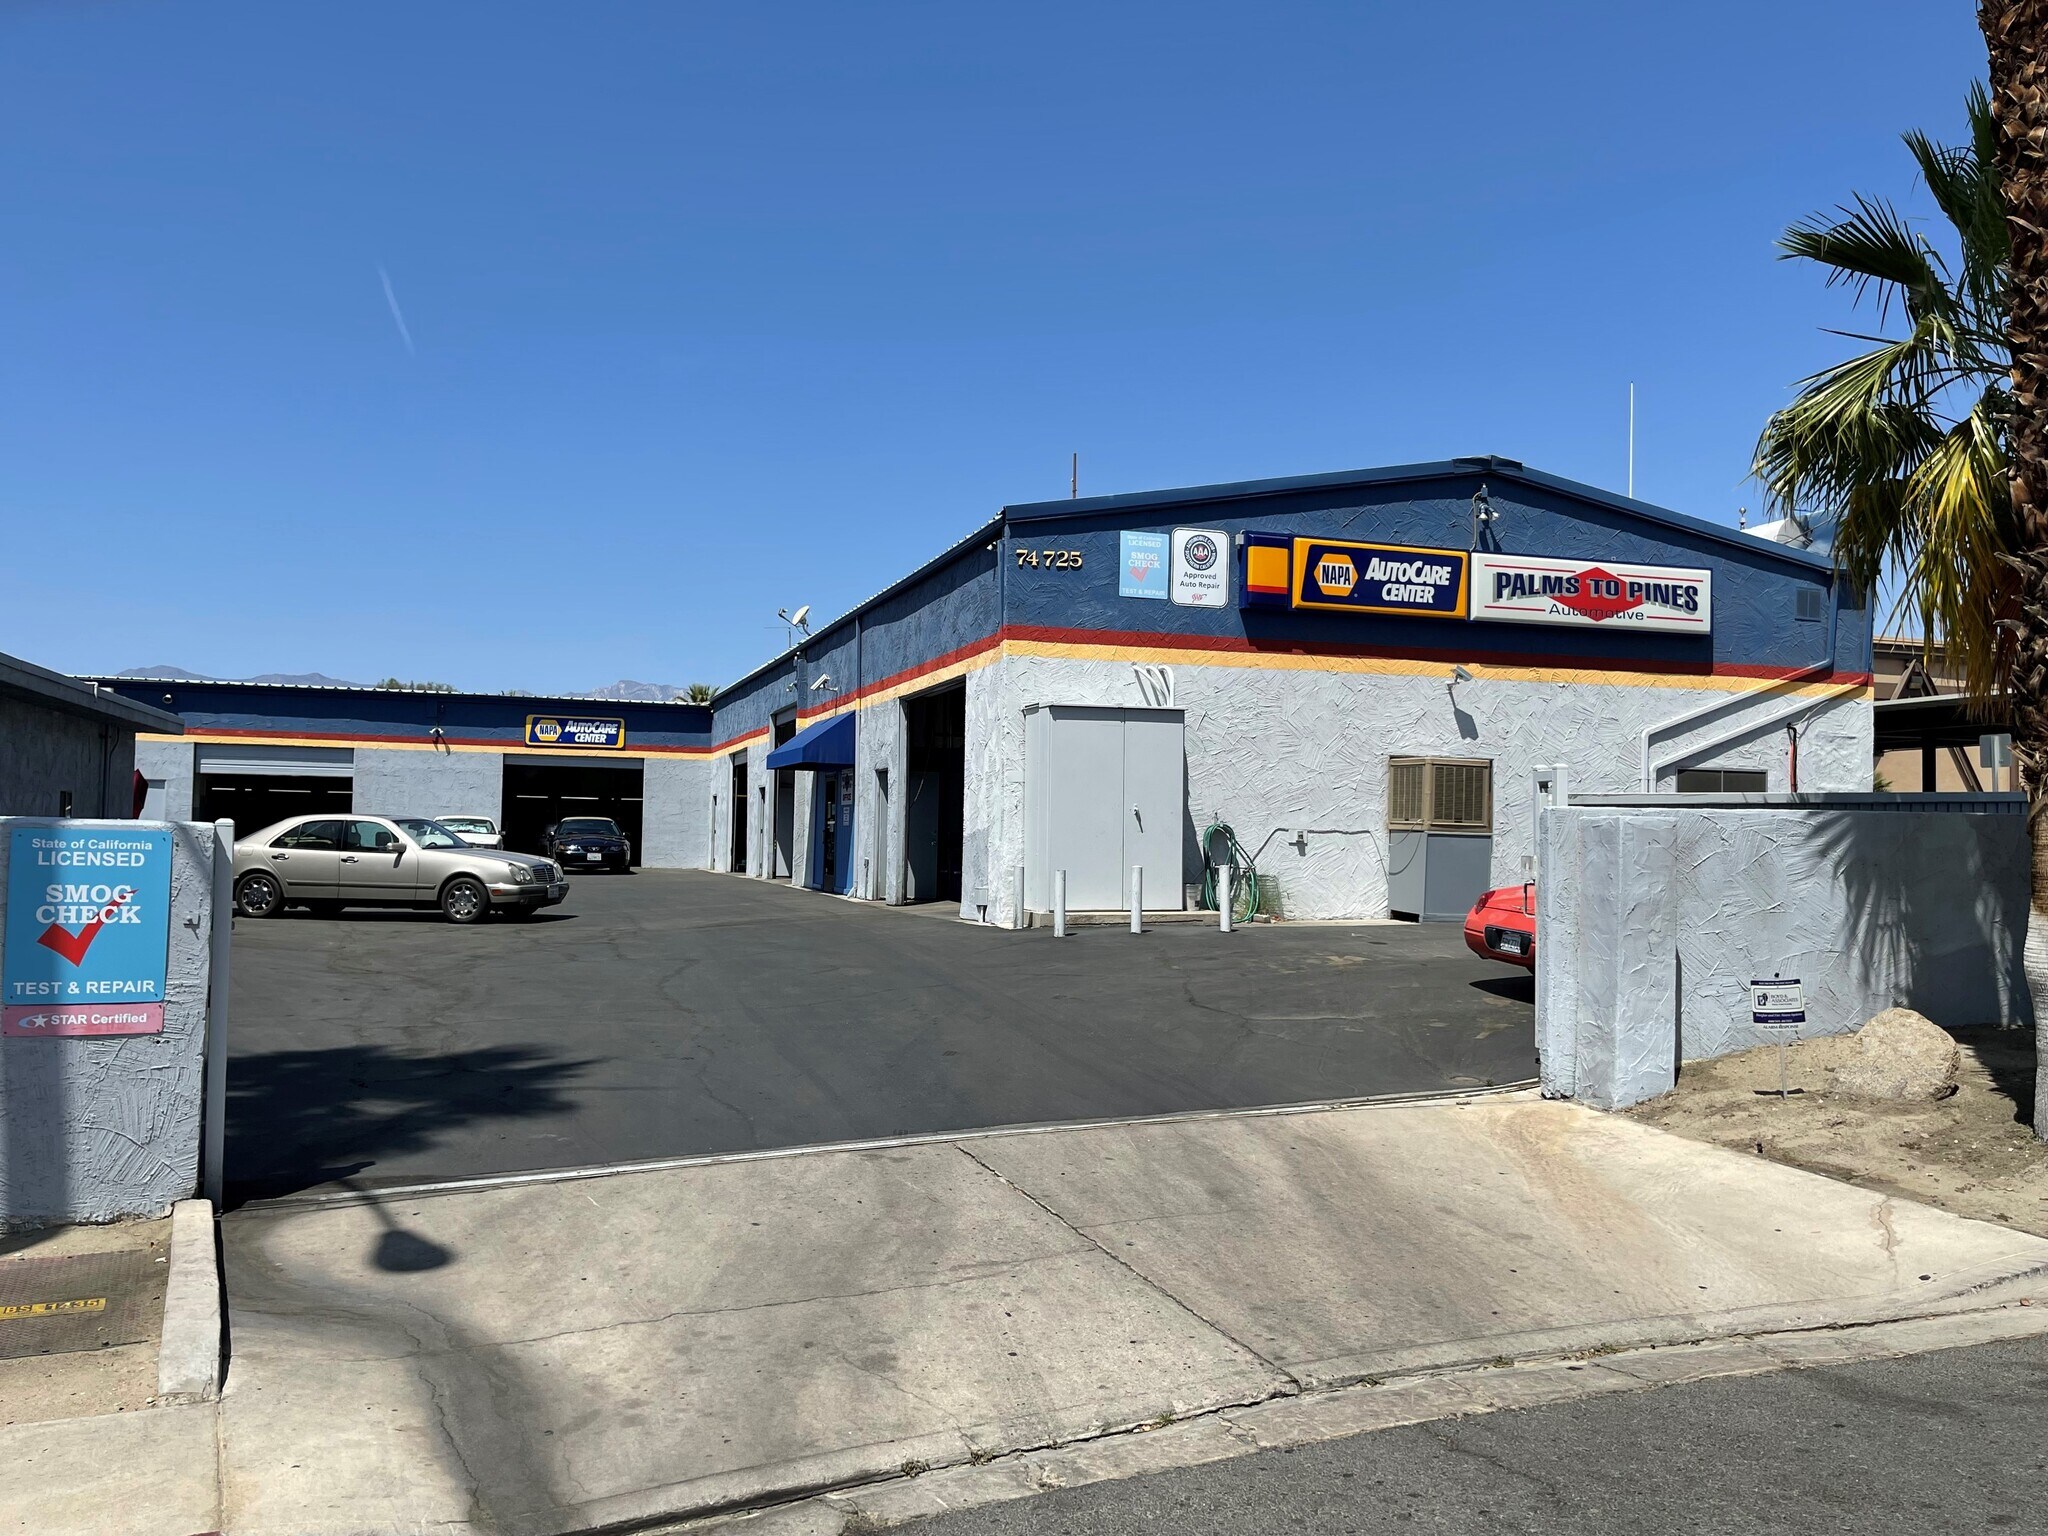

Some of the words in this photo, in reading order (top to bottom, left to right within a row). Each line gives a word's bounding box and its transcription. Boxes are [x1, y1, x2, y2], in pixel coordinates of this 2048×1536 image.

[1128, 540, 1161, 548] LICENSED
[1193, 547, 1208, 556] AAA
[1016, 549, 1039, 567] 74
[1043, 550, 1083, 568] 725
[1128, 559, 1160, 568] CHECK
[1131, 552, 1158, 560] SMOG
[1183, 572, 1216, 580] Approved
[1321, 564, 1350, 586] NAPA
[1364, 557, 1452, 586] AUTOCARE
[1381, 583, 1435, 603] CENTER
[1494, 572, 1579, 601] PALMS
[1589, 578, 1620, 598] TO
[1629, 581, 1698, 613] PINES
[1549, 603, 1644, 621] Automotive
[539, 724, 558, 735] NAPA
[574, 733, 607, 743] CENTER
[32, 838, 67, 849] State
[70, 838, 85, 849] of
[88, 839, 152, 850] California
[37, 851, 145, 867] LICENSED
[46, 884, 133, 903] SMOG
[35, 905, 141, 924] CHECK
[13, 981, 62, 995] TEST
[67, 981, 80, 994] &
[86, 980, 155, 994] REPAIR
[51, 1014, 87, 1025] STAR
[91, 1013, 147, 1025] Certified
